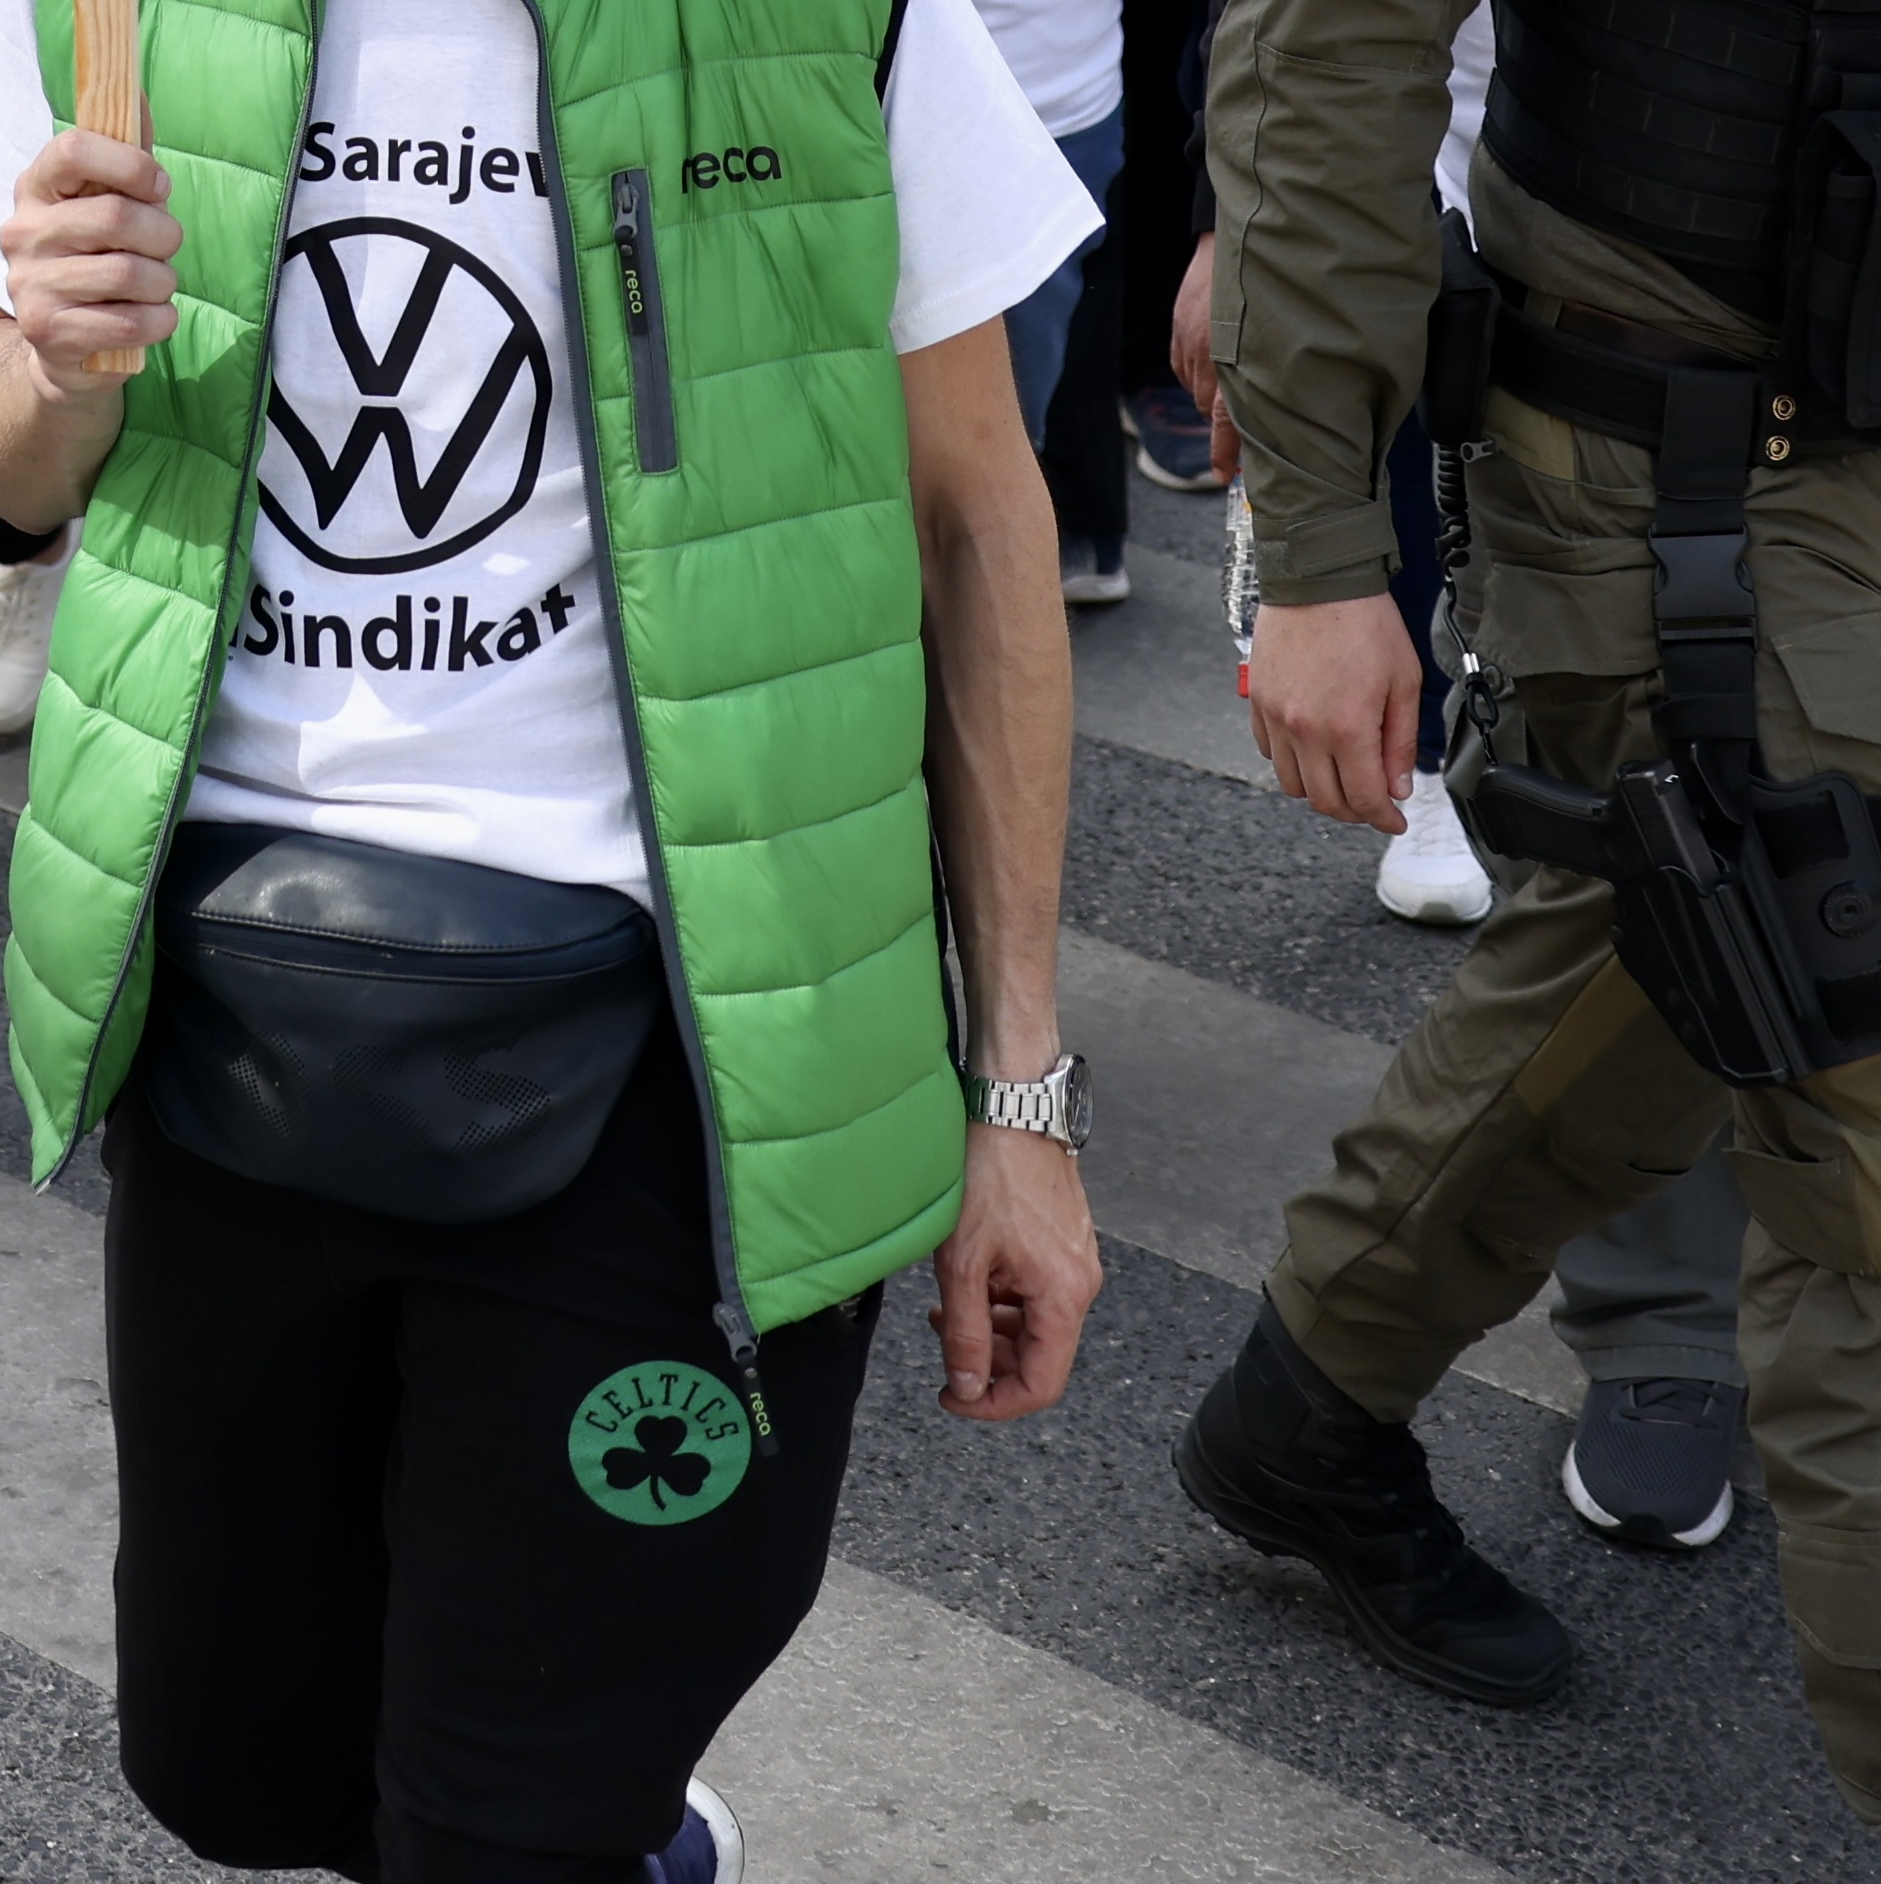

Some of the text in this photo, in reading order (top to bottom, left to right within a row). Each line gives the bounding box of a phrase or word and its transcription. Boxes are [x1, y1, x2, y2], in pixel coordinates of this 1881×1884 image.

[681, 146, 782, 194] reca
[625, 269, 643, 314] reca
[243, 583, 577, 673] Sindikat
[584, 1372, 740, 1443] CELTICS
[749, 1391, 771, 1437] reca
